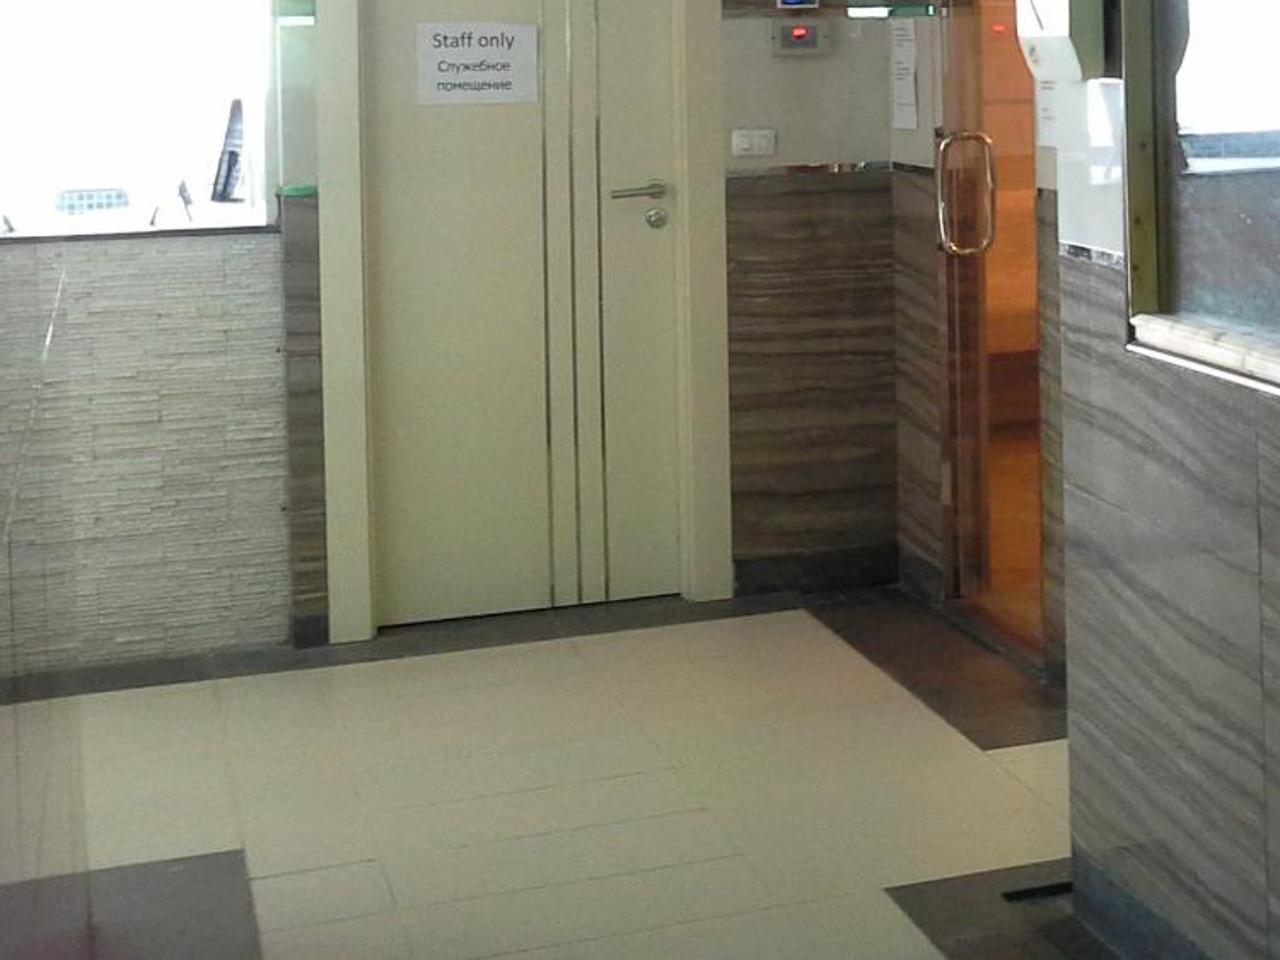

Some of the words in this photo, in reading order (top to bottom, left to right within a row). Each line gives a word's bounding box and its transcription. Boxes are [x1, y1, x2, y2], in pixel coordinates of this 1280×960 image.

[432, 31, 473, 48] Staff
[478, 31, 515, 50] only
[437, 60, 511, 73] Служебное
